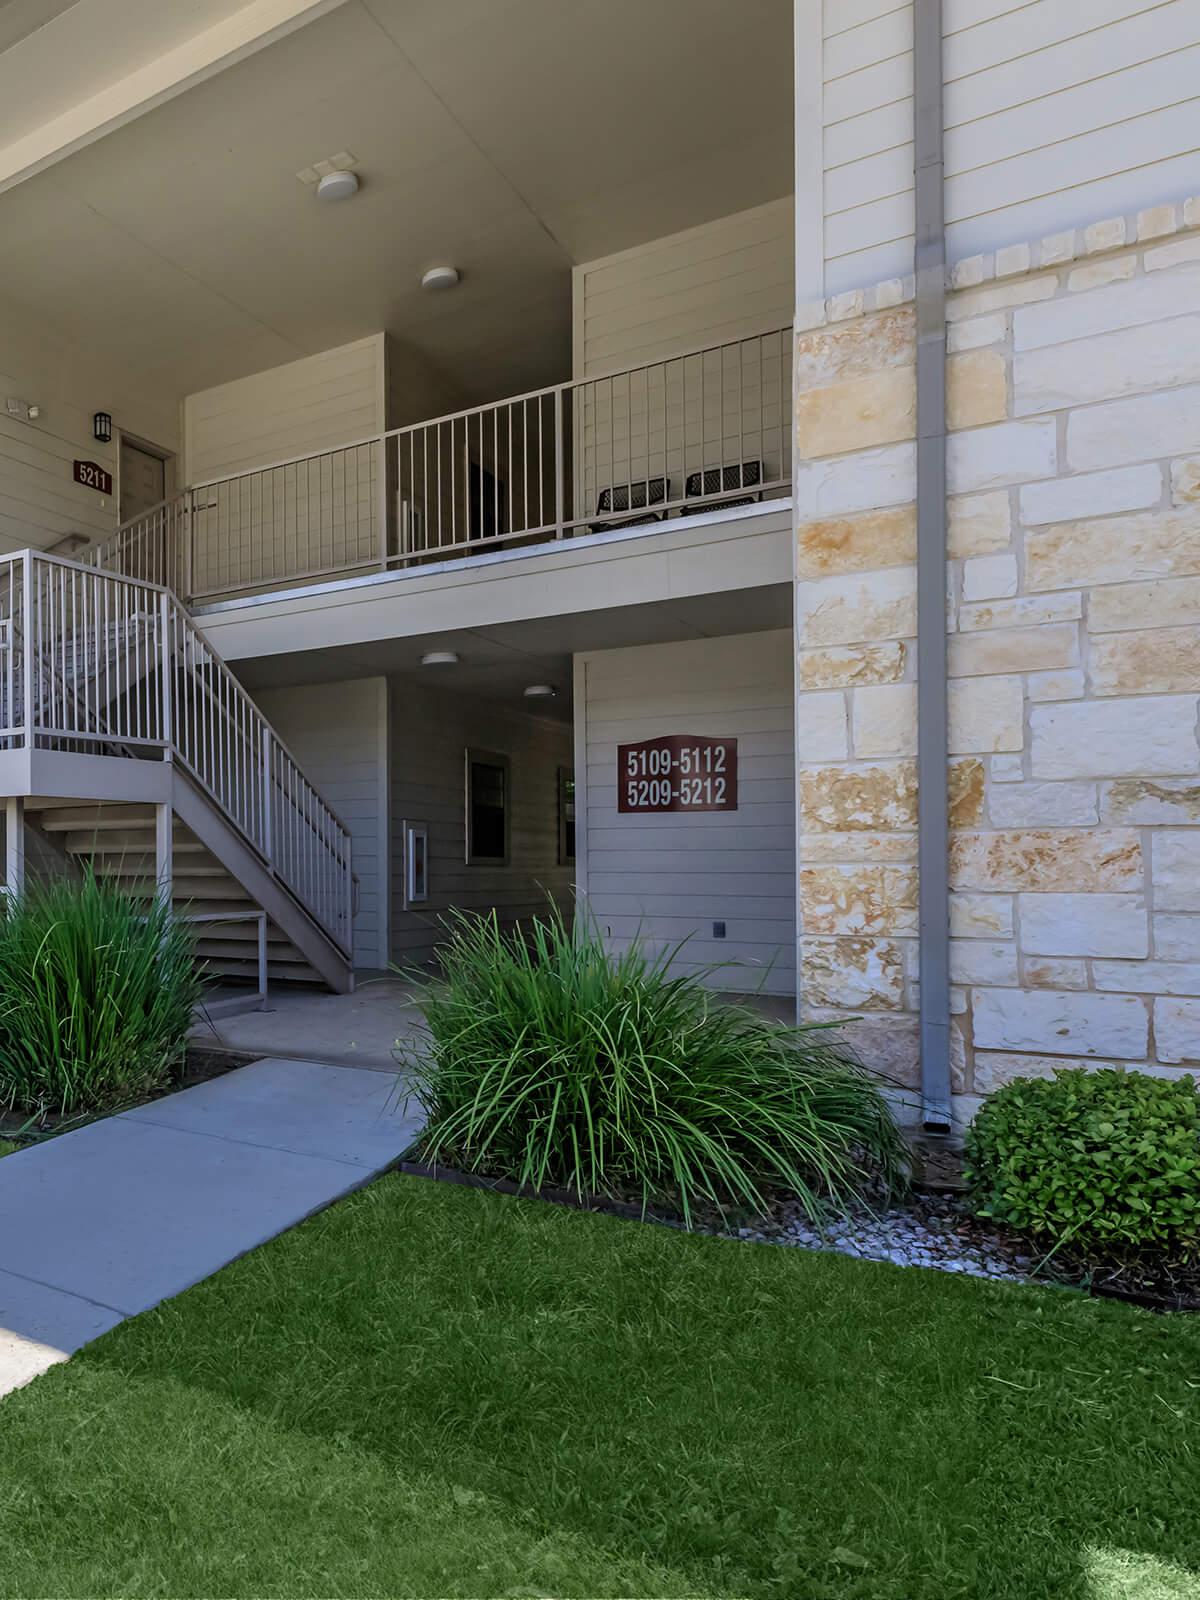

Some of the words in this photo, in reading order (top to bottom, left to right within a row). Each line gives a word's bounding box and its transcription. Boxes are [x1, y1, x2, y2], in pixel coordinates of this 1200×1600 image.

[80, 464, 105, 490] 5211
[627, 745, 726, 776] 5109-5112
[627, 777, 726, 806] 5209-5212
